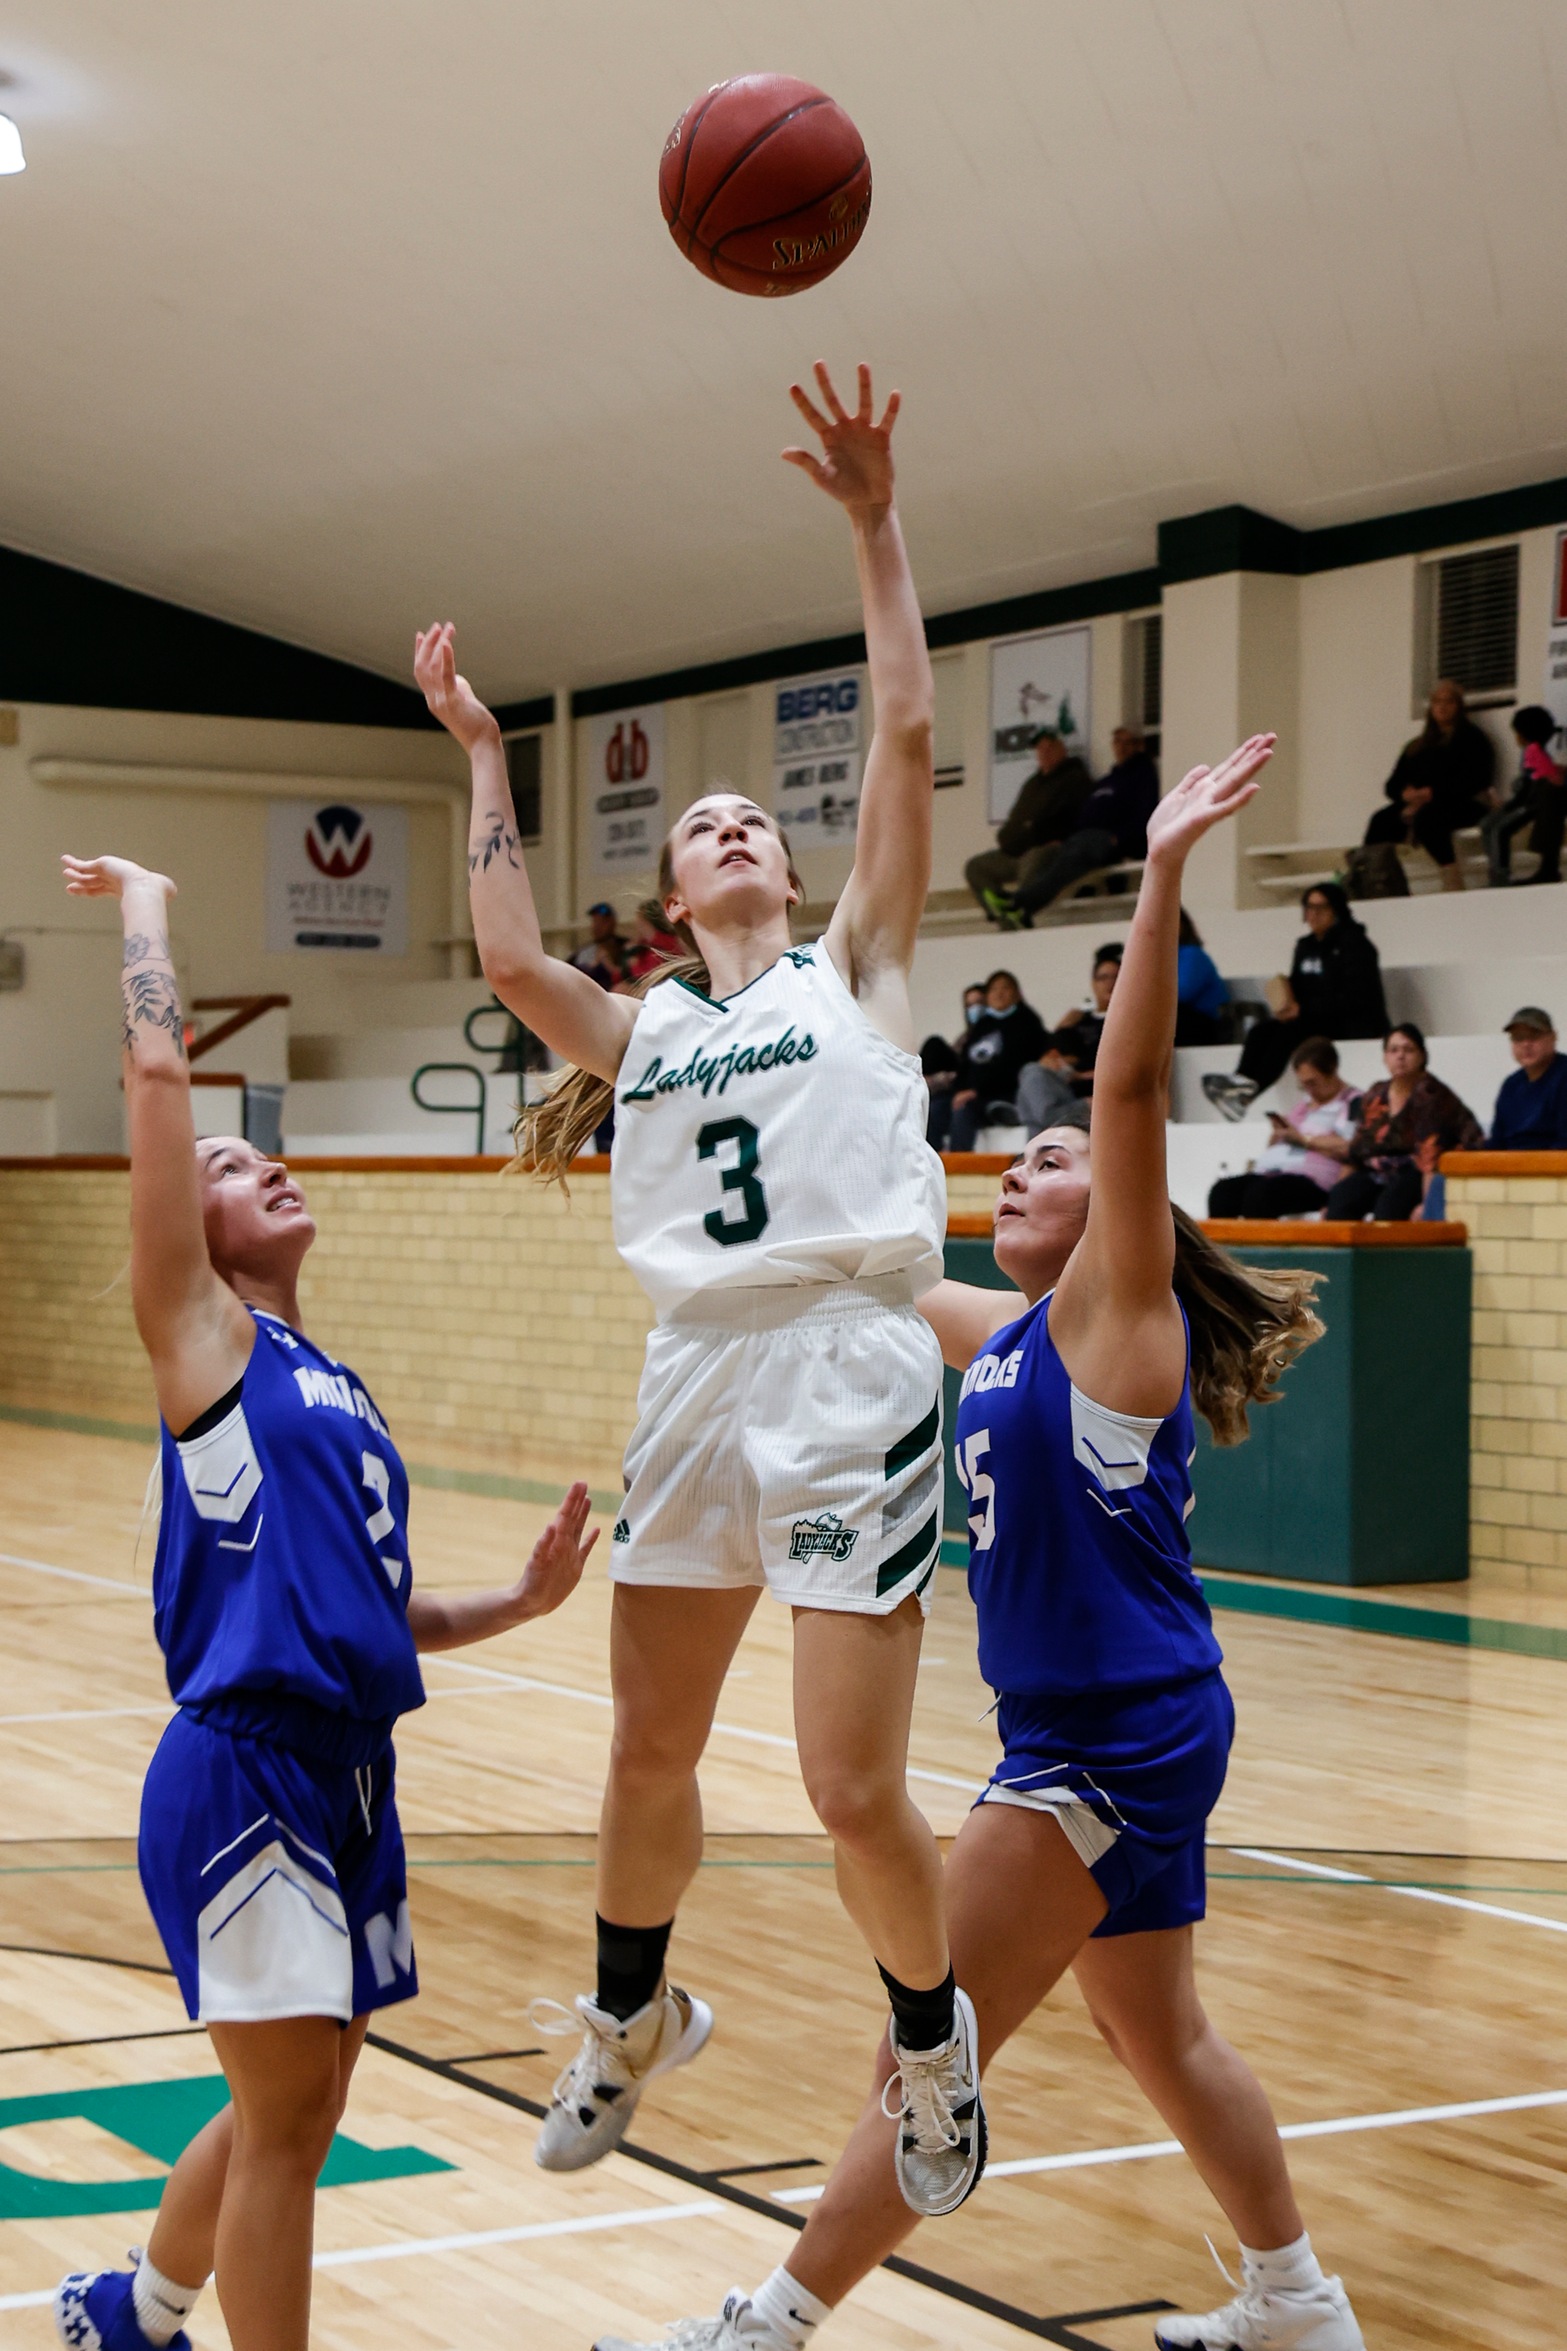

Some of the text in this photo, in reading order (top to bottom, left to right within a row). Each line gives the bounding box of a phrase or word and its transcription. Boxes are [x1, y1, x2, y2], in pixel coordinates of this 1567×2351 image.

[778, 679, 858, 724] BERG
[620, 1025, 819, 1105] Ladyjacks
[695, 1114, 770, 1247] 3
[789, 1530, 858, 1560] LADYJACKS
